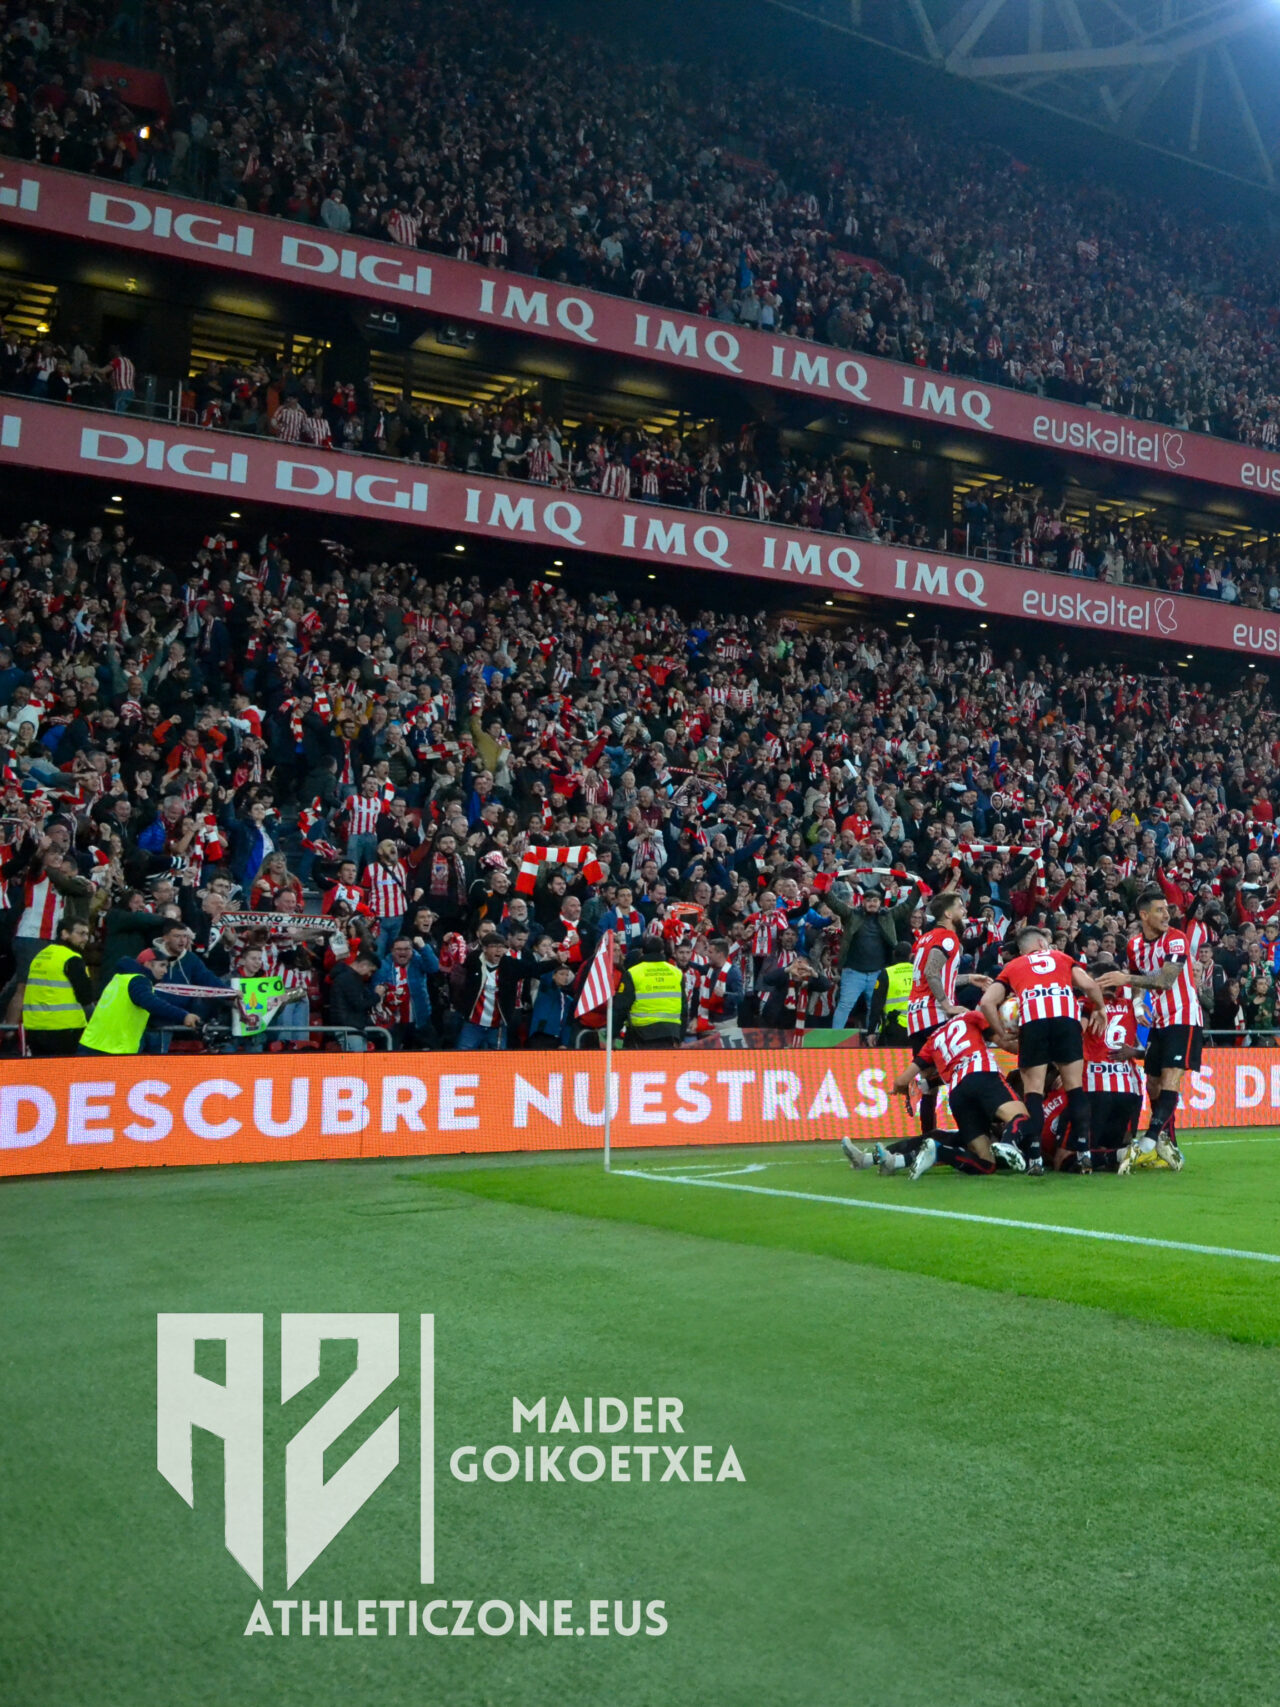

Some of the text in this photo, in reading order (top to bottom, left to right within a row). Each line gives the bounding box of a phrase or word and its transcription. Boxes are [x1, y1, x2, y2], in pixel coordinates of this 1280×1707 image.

[87, 191, 255, 257] DIGI
[280, 235, 433, 297] DIGI
[478, 279, 599, 344] IMQ
[633, 314, 744, 374] IMQ
[770, 346, 872, 402] IMQ
[902, 377, 994, 430] IMQ
[79, 427, 249, 484] DIGI
[1033, 415, 1159, 463] euskaltel
[275, 459, 429, 512] DIGI
[464, 488, 587, 546] IMQ
[622, 515, 733, 568] IMQ
[762, 537, 864, 587] IMQ
[895, 559, 988, 608] IMQ
[1022, 589, 1150, 631] euskaltel
[1027, 949, 1057, 975] 5
[1025, 987, 1070, 999] DIGI
[1104, 1003, 1129, 1014] ESGA
[933, 1019, 972, 1066] 12
[1104, 1014, 1127, 1050] 6
[1090, 1063, 1130, 1073] DIGI
[0, 1067, 889, 1149] DESCUBRE NUESTRAS
